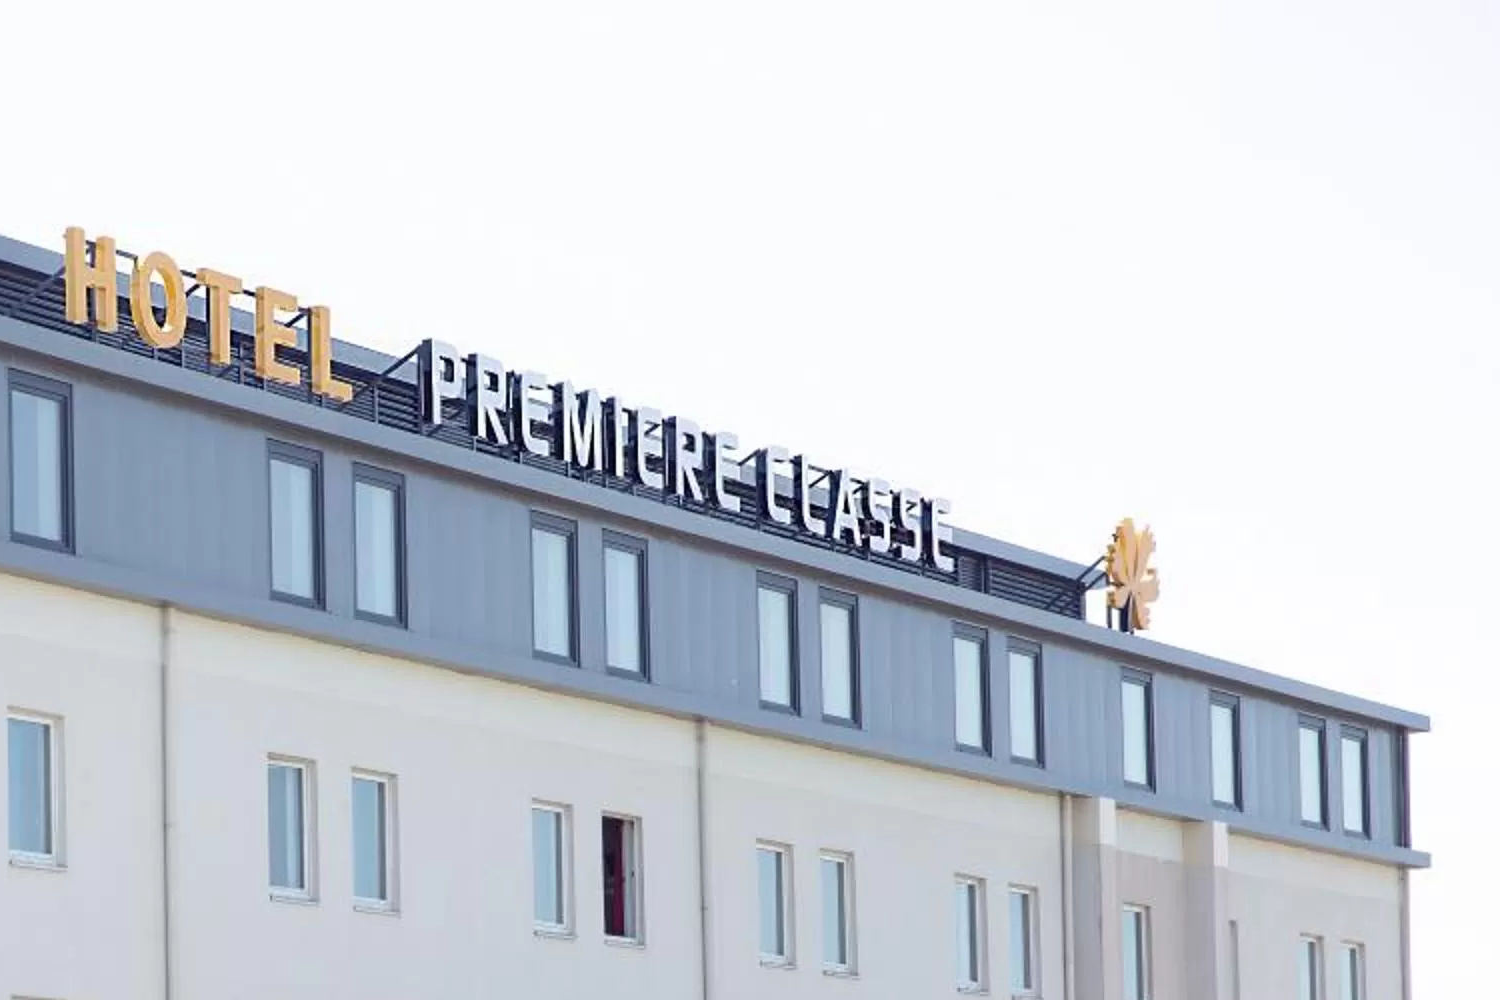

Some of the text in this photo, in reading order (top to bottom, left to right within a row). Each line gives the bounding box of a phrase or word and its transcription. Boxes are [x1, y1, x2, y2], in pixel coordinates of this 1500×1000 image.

[64, 226, 353, 403] HOTEL
[421, 338, 956, 572] PREMIERE CLASSE
